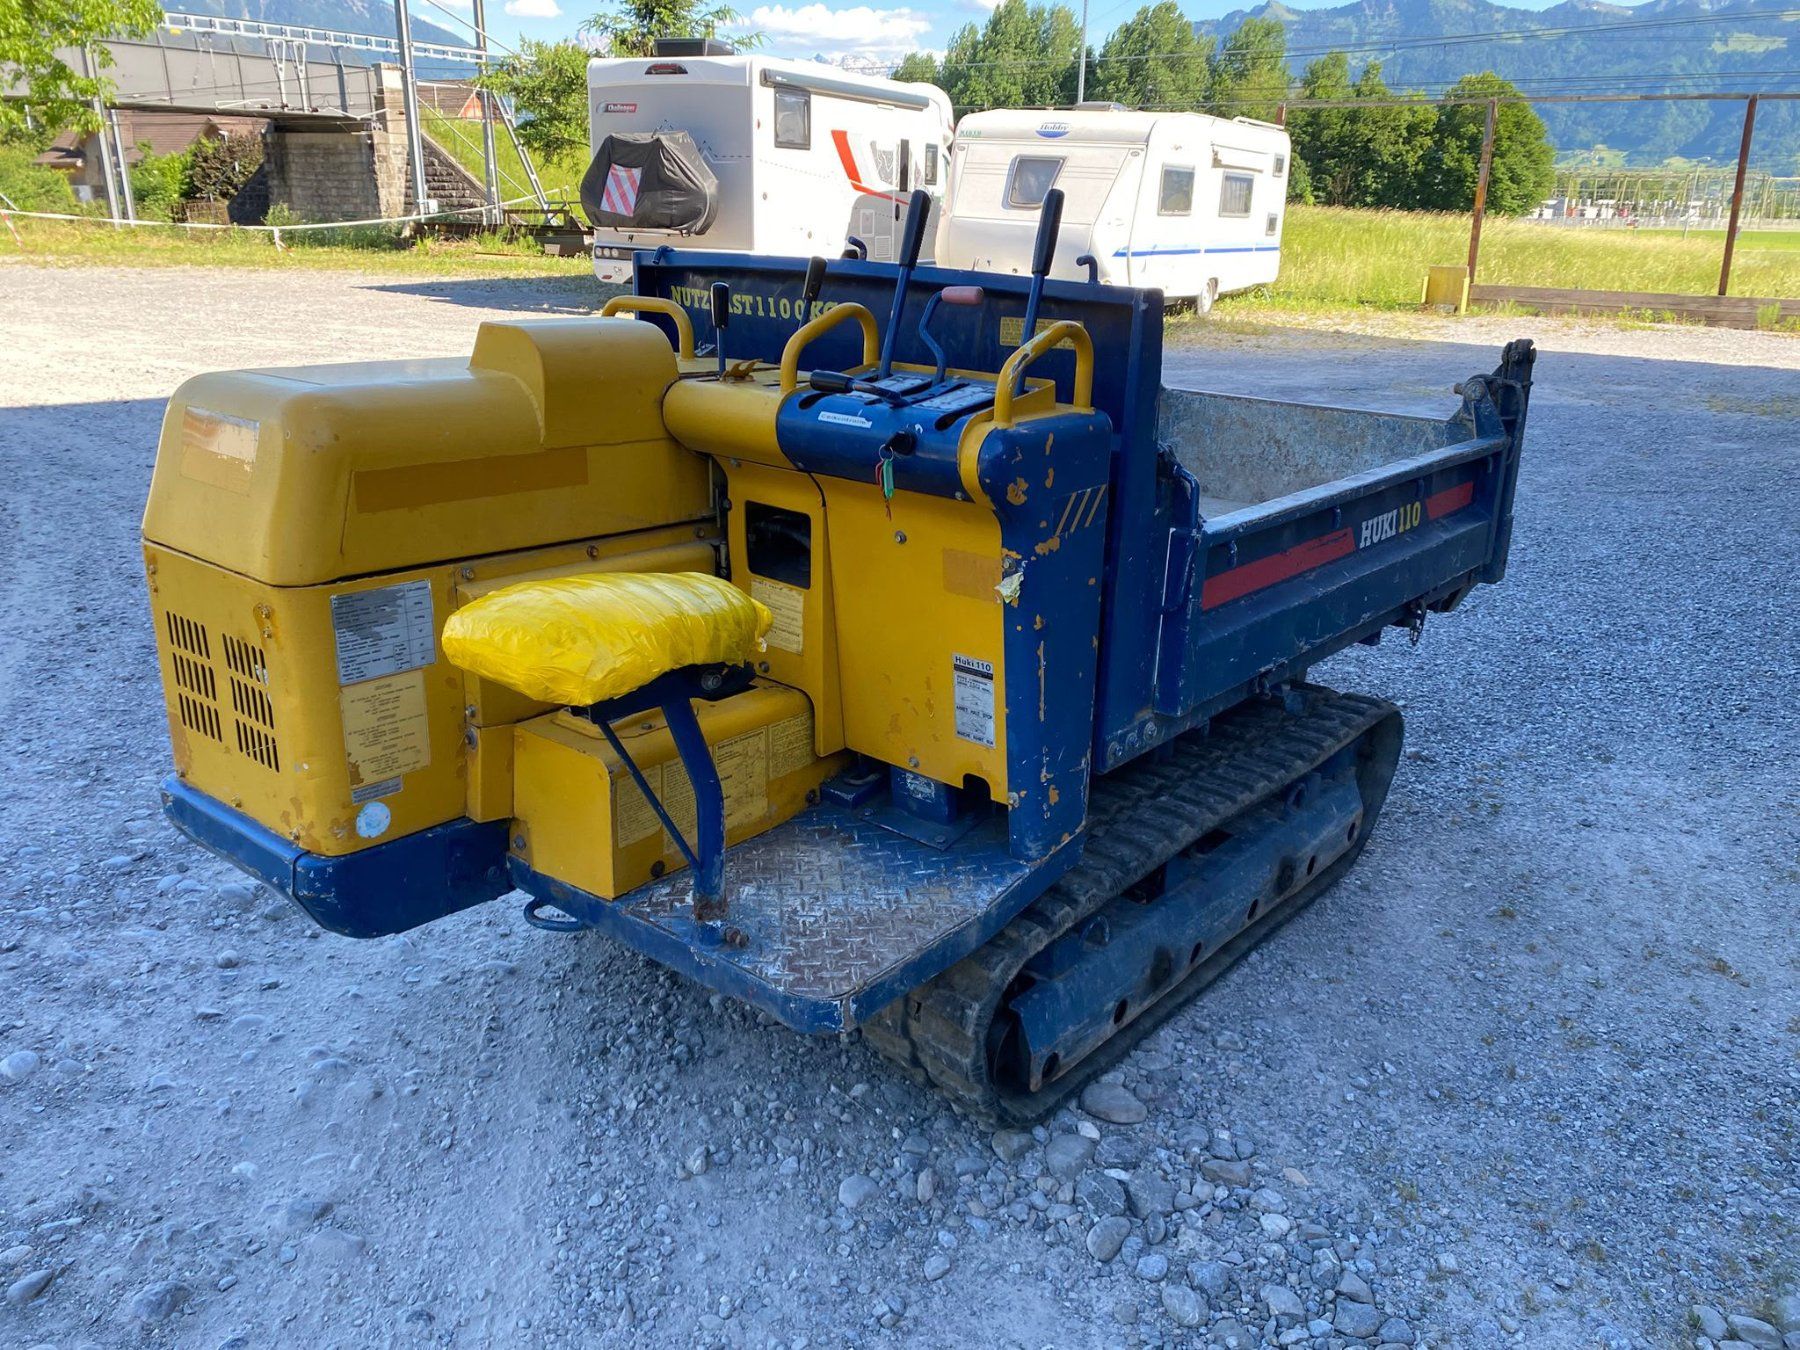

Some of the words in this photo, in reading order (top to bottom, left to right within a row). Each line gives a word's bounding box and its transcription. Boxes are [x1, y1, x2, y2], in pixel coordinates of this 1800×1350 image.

[671, 285, 753, 316] NUTZST
[1359, 509, 1398, 549] HUKI
[1398, 501, 1421, 533] 110
[955, 655, 974, 668] Huki
[976, 661, 991, 672] 110
